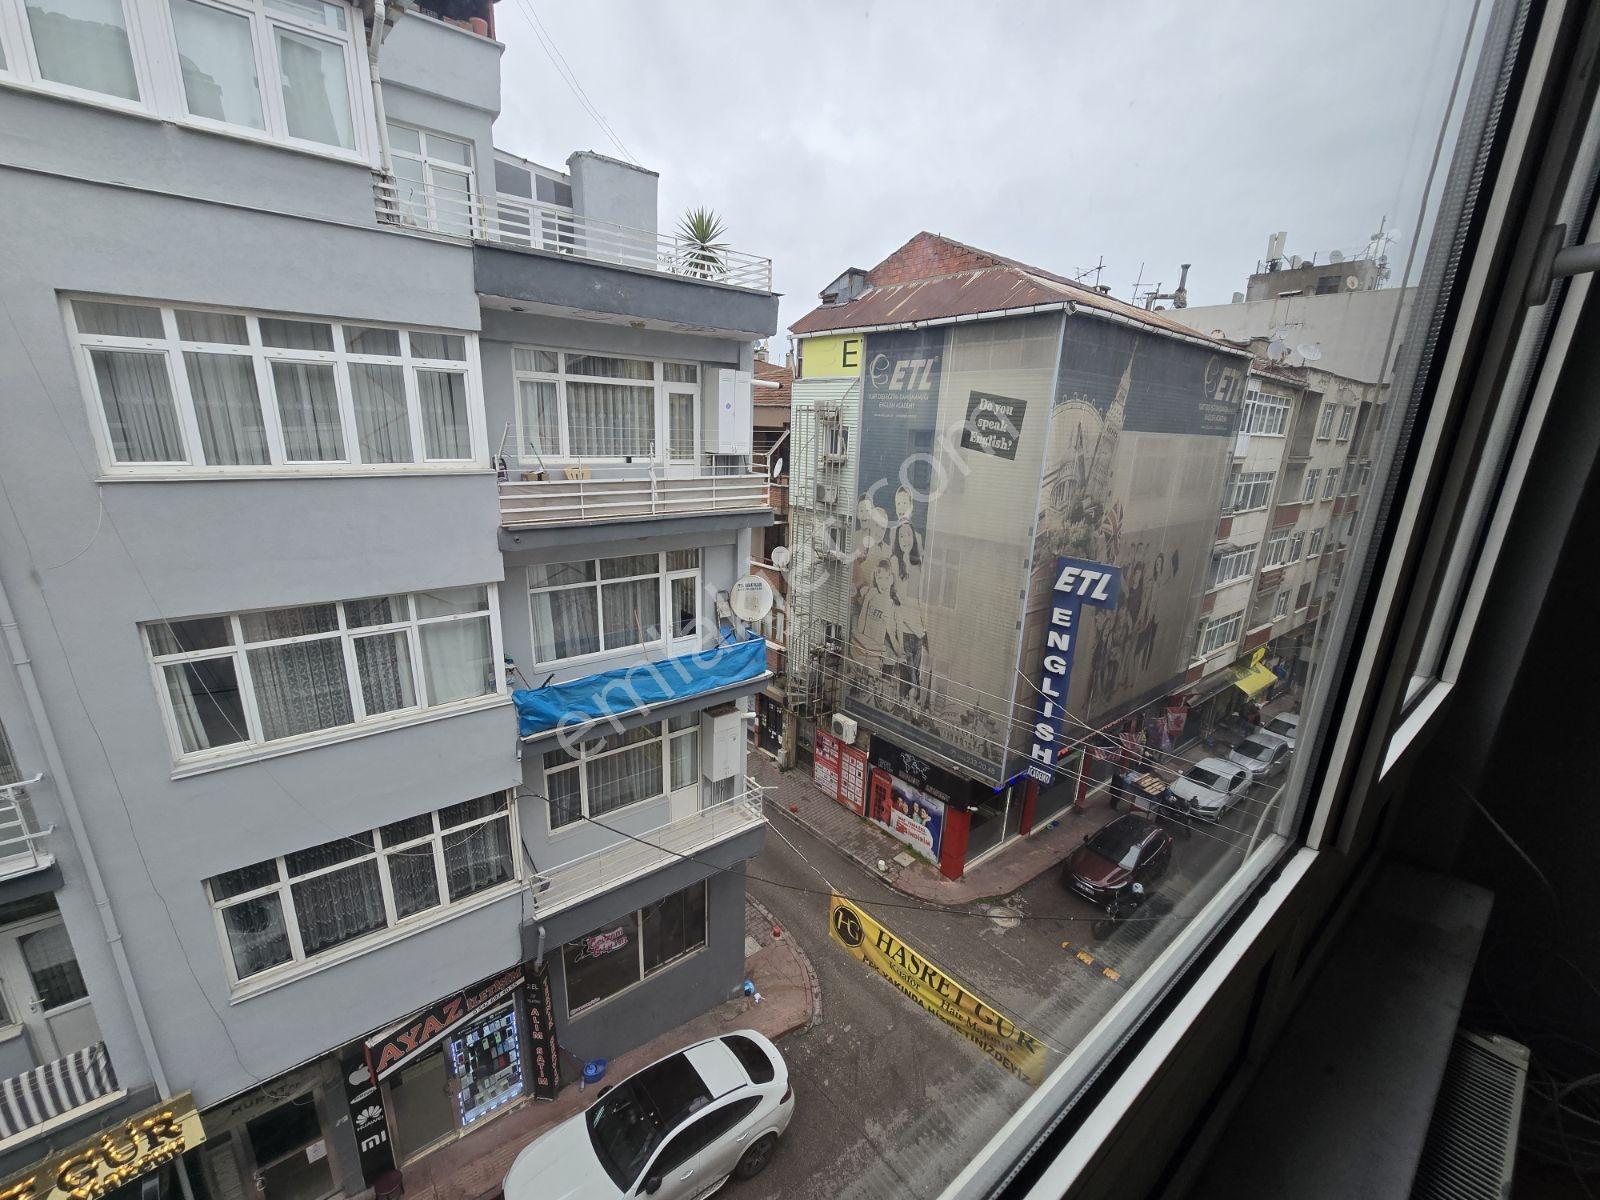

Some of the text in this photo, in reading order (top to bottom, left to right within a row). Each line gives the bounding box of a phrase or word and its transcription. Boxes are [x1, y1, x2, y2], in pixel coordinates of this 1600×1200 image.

[888, 358, 934, 391] ETL
[978, 397, 1014, 416] Do you
[969, 430, 1014, 451] English?
[976, 417, 1009, 433] speak
[1053, 565, 1113, 602] ETL
[1030, 606, 1073, 767] ENGLISH
[376, 996, 464, 1074] AYAZ
[530, 1007, 544, 1040] ALIM
[535, 1046, 549, 1087] SATIM
[356, 1114, 385, 1132] HUAWEI
